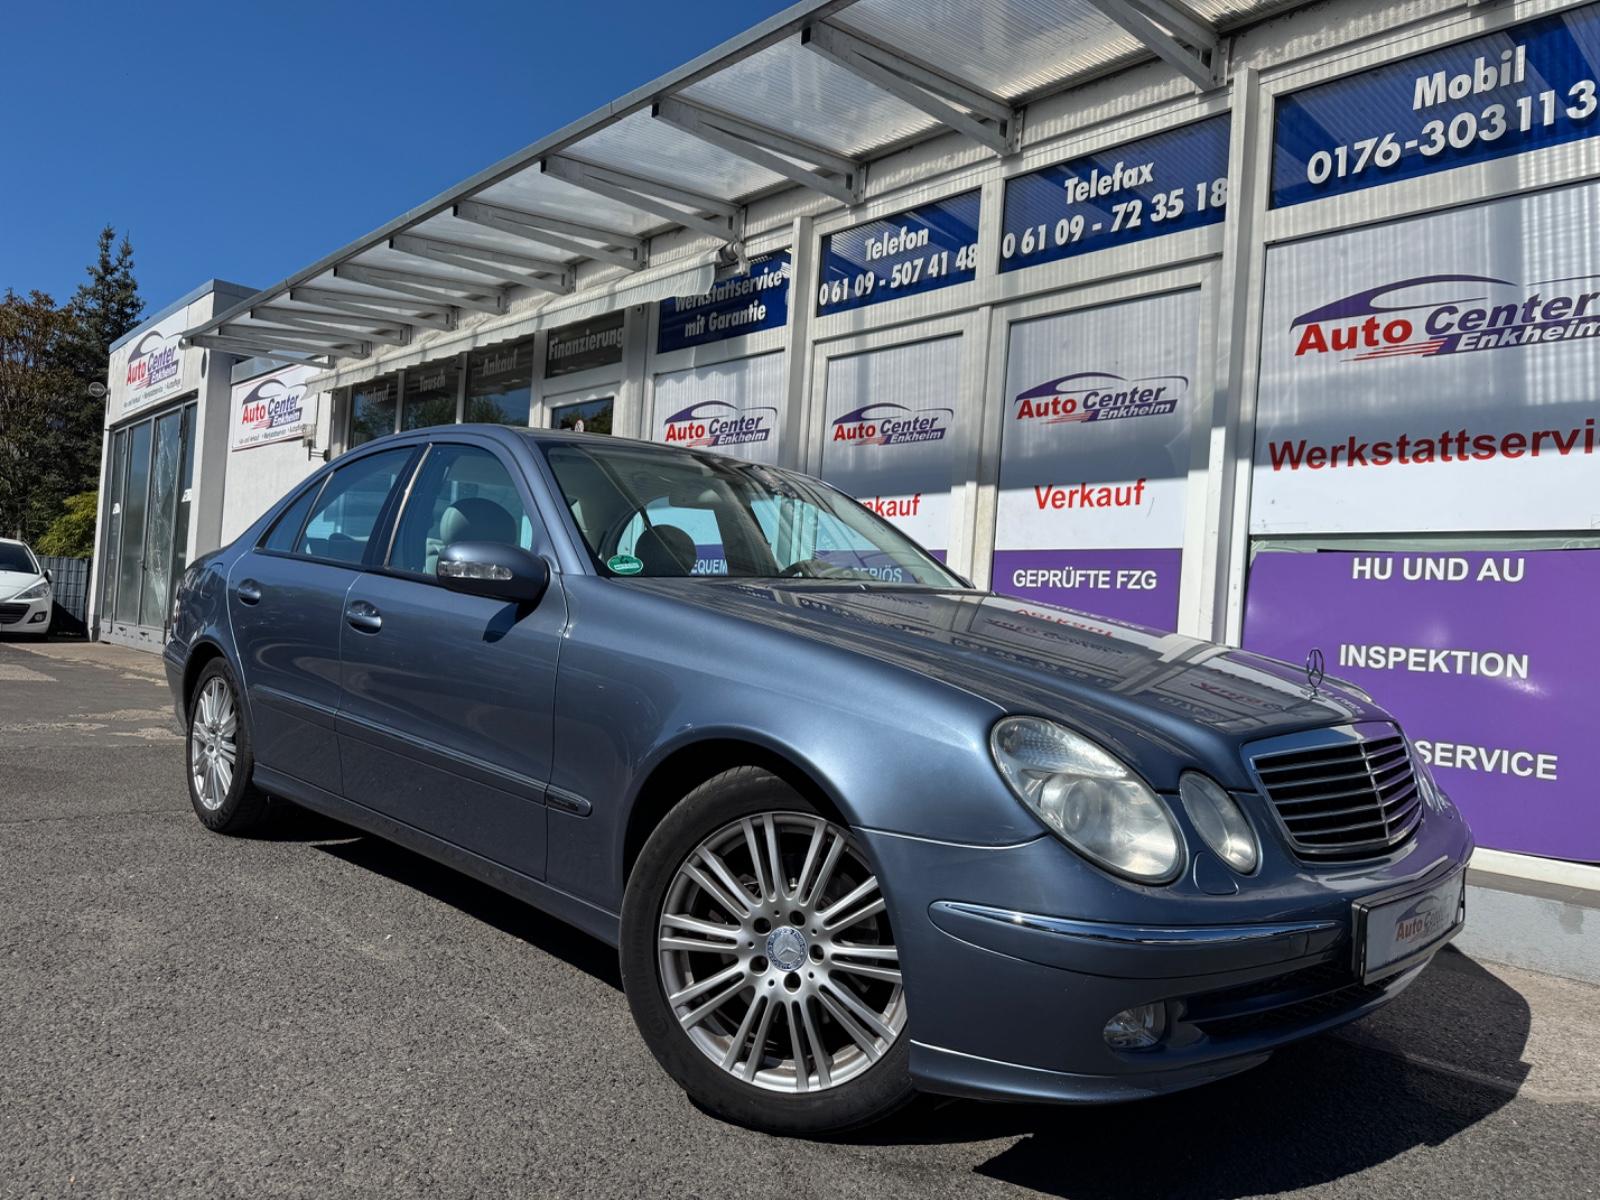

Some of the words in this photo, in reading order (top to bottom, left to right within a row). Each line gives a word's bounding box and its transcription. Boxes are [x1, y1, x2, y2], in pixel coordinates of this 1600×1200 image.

[1412, 45, 1527, 111] Mobil
[1064, 161, 1155, 205] Telefax
[1055, 214, 1085, 246] 09
[1110, 199, 1143, 233] 72
[1151, 188, 1184, 223] 35
[1197, 177, 1228, 212] 18
[864, 226, 929, 261] Telefon
[854, 274, 874, 297] 09
[891, 258, 922, 289] 507
[927, 251, 948, 279] 41
[955, 243, 978, 270] 48
[685, 314, 706, 338] mit
[708, 299, 766, 332] Garantie
[1294, 316, 1413, 356] Auto
[1424, 292, 1600, 336] Center
[1455, 318, 1600, 352] Enkheim
[549, 328, 624, 361] Finanzierung
[127, 359, 146, 386] Auto
[148, 345, 176, 373] Center
[242, 402, 266, 425] Auto
[268, 394, 299, 417] Center
[1016, 396, 1077, 420] Auto
[1083, 385, 1167, 410] Center
[1097, 401, 1171, 420] Enkheim
[665, 422, 705, 442] Auto
[709, 415, 763, 434] Center
[718, 431, 767, 445] Enkheim
[833, 423, 876, 442] Auto
[880, 415, 938, 434] Center
[890, 429, 941, 444] Enkheim
[1267, 418, 1600, 472] Werkstattservi
[863, 492, 922, 517] nkauf
[1034, 477, 1148, 511] Verkauf
[1013, 566, 1111, 590] GEPRÜFTE
[1116, 570, 1158, 590] FZG
[1352, 557, 1393, 580] HU
[1403, 557, 1469, 582] UND
[1476, 557, 1526, 583] AU
[1338, 644, 1529, 679] INSPEKTION
[1414, 740, 1558, 780] SERVICE
[1395, 918, 1424, 942] Auto
